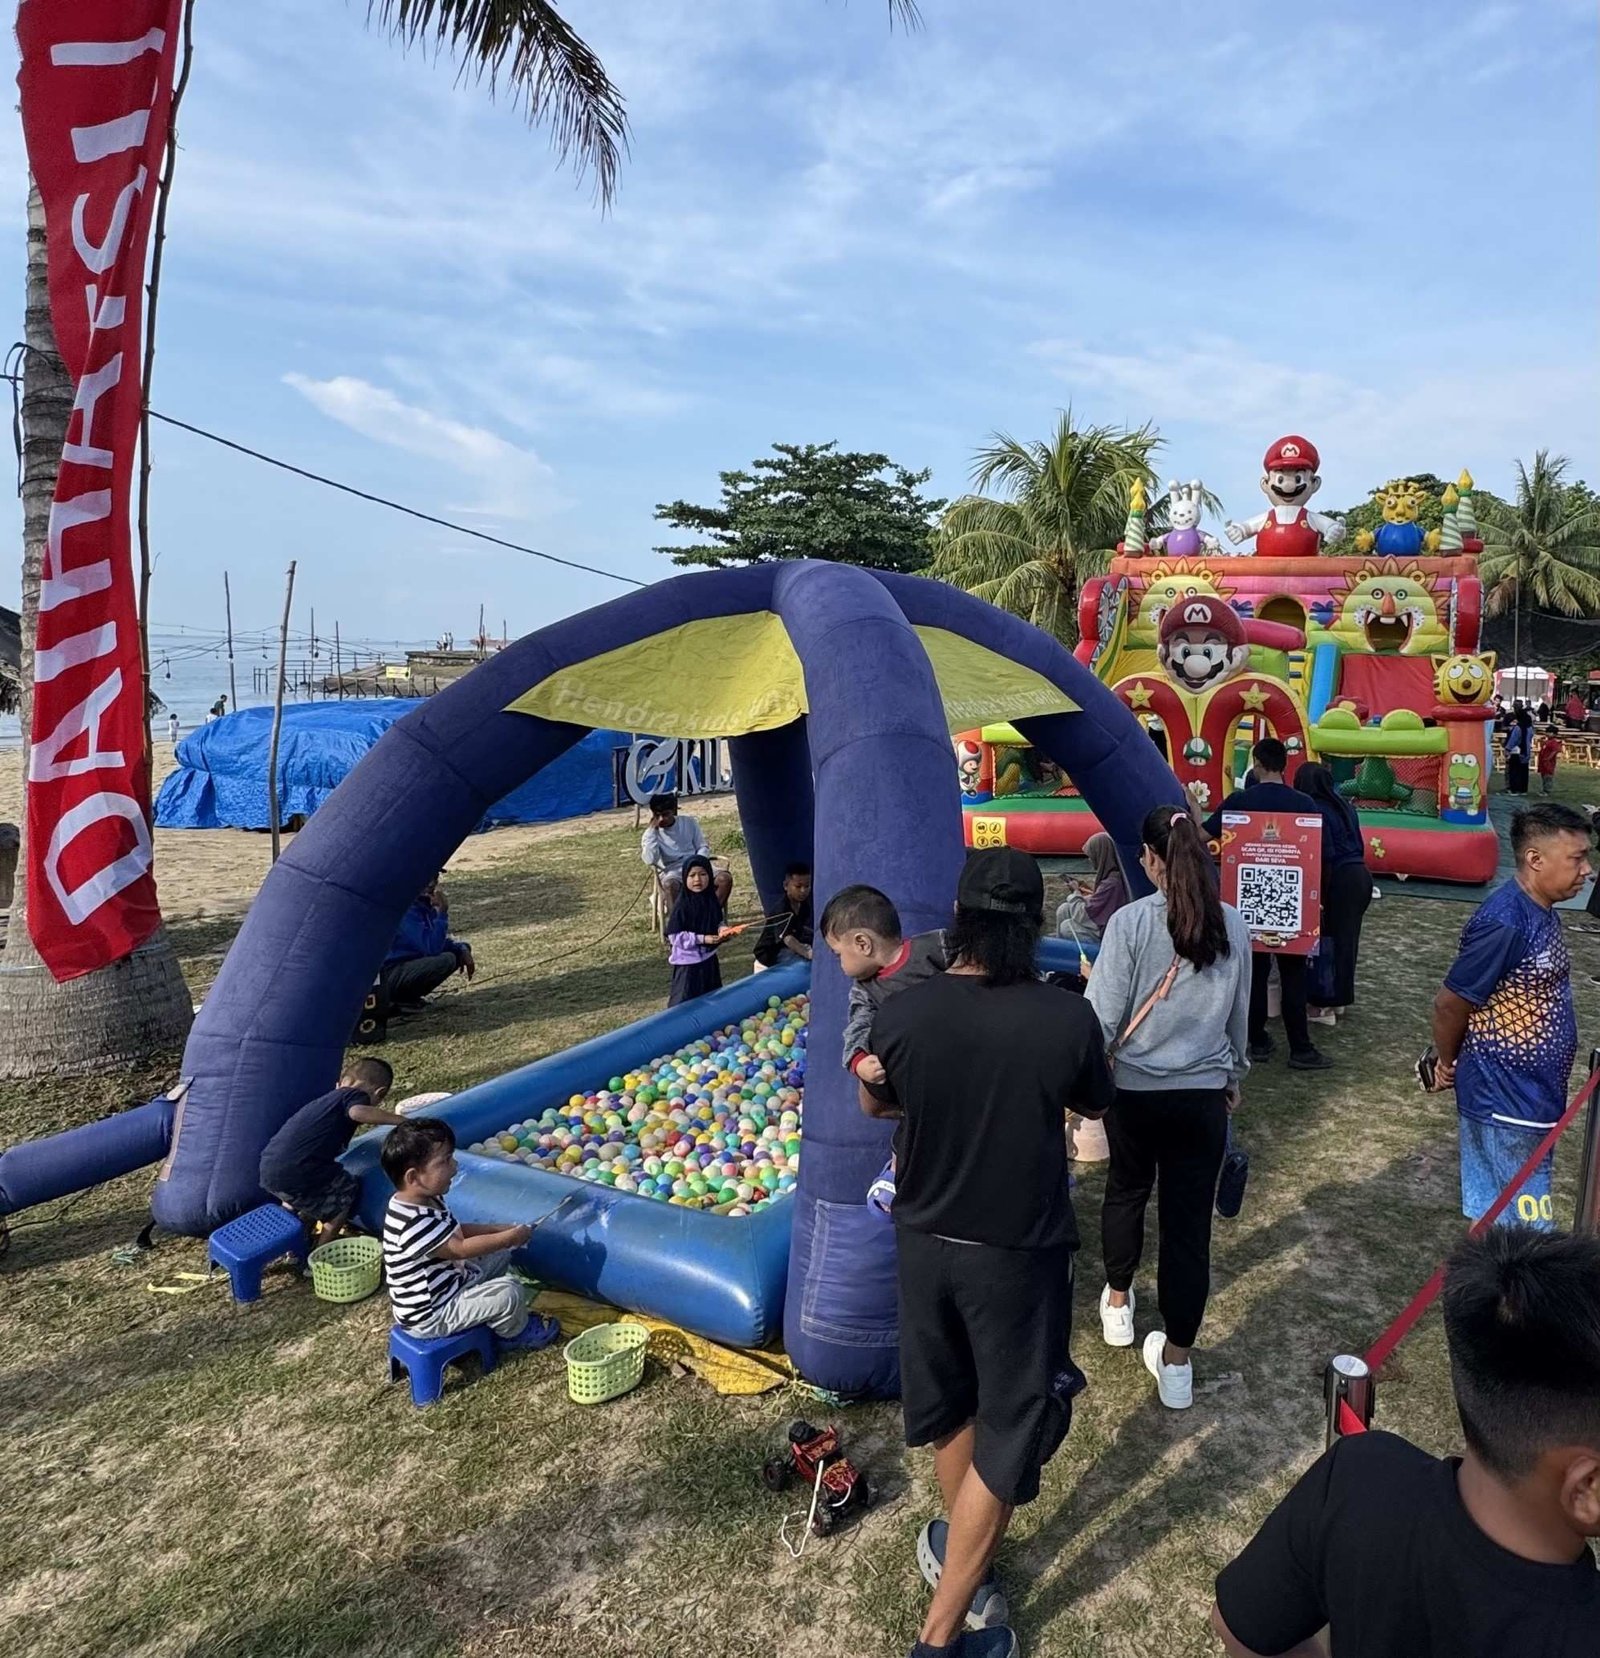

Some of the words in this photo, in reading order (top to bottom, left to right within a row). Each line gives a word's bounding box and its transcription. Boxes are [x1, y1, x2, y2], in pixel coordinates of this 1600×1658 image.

[1283, 446, 1298, 456] M
[29, 26, 167, 927] DAIHATSU
[1186, 606, 1209, 622] M
